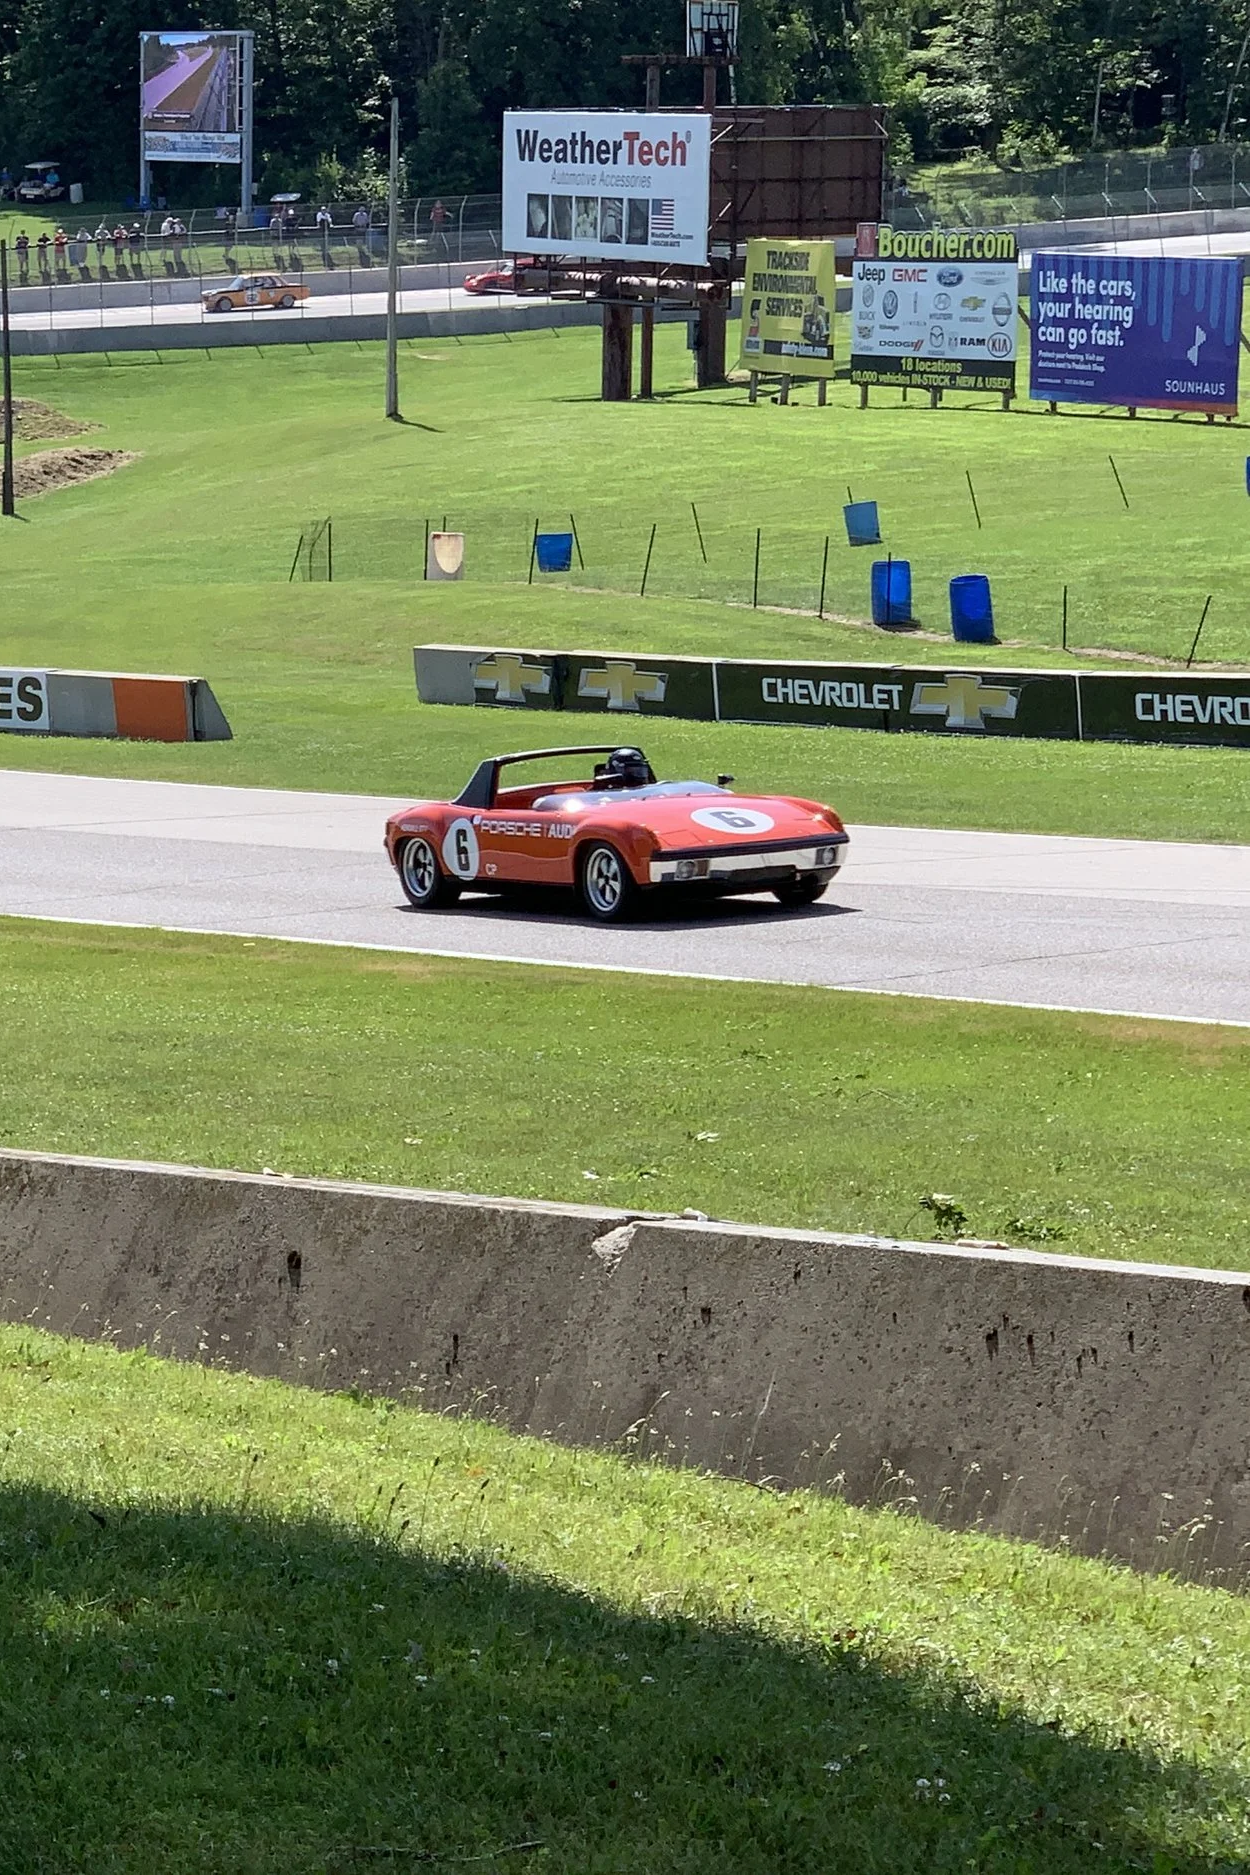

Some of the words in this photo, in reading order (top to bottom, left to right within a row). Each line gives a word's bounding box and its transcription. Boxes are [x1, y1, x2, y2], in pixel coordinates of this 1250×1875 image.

[551, 169, 597, 185] Automotive
[599, 171, 652, 188] Accessories
[877, 223, 1015, 259] Boucher.com
[767, 250, 810, 271] TRACKSIDE
[752, 272, 817, 295] ENVIRONMENTAL
[857, 264, 886, 285] Jeep
[892, 268, 928, 282] GMC
[1039, 271, 1067, 294] Like
[1071, 272, 1096, 295] the
[1099, 278, 1136, 300] cars,
[765, 297, 804, 318] SERVICES
[1038, 302, 1072, 323] your
[1074, 297, 1134, 329] hearing
[879, 340, 916, 348] DODGE
[959, 337, 986, 346] RAM
[991, 338, 1008, 352] KIA
[1038, 325, 1065, 343] can
[1068, 328, 1088, 350] go
[1090, 323, 1124, 347] fast.
[901, 357, 913, 370] 18
[915, 358, 962, 373] locations
[851, 370, 877, 383] 10,000
[878, 372, 910, 383] vehicles
[911, 374, 951, 386] IN-STOCK
[956, 376, 976, 387] NEW
[977, 376, 983, 387] &
[985, 377, 1012, 389] USED!
[1165, 380, 1226, 395] SOUNHAUS
[761, 676, 904, 710] CHEVROLET
[480, 820, 541, 837] PORSCHE
[710, 811, 756, 829] 6
[455, 828, 471, 873] 6
